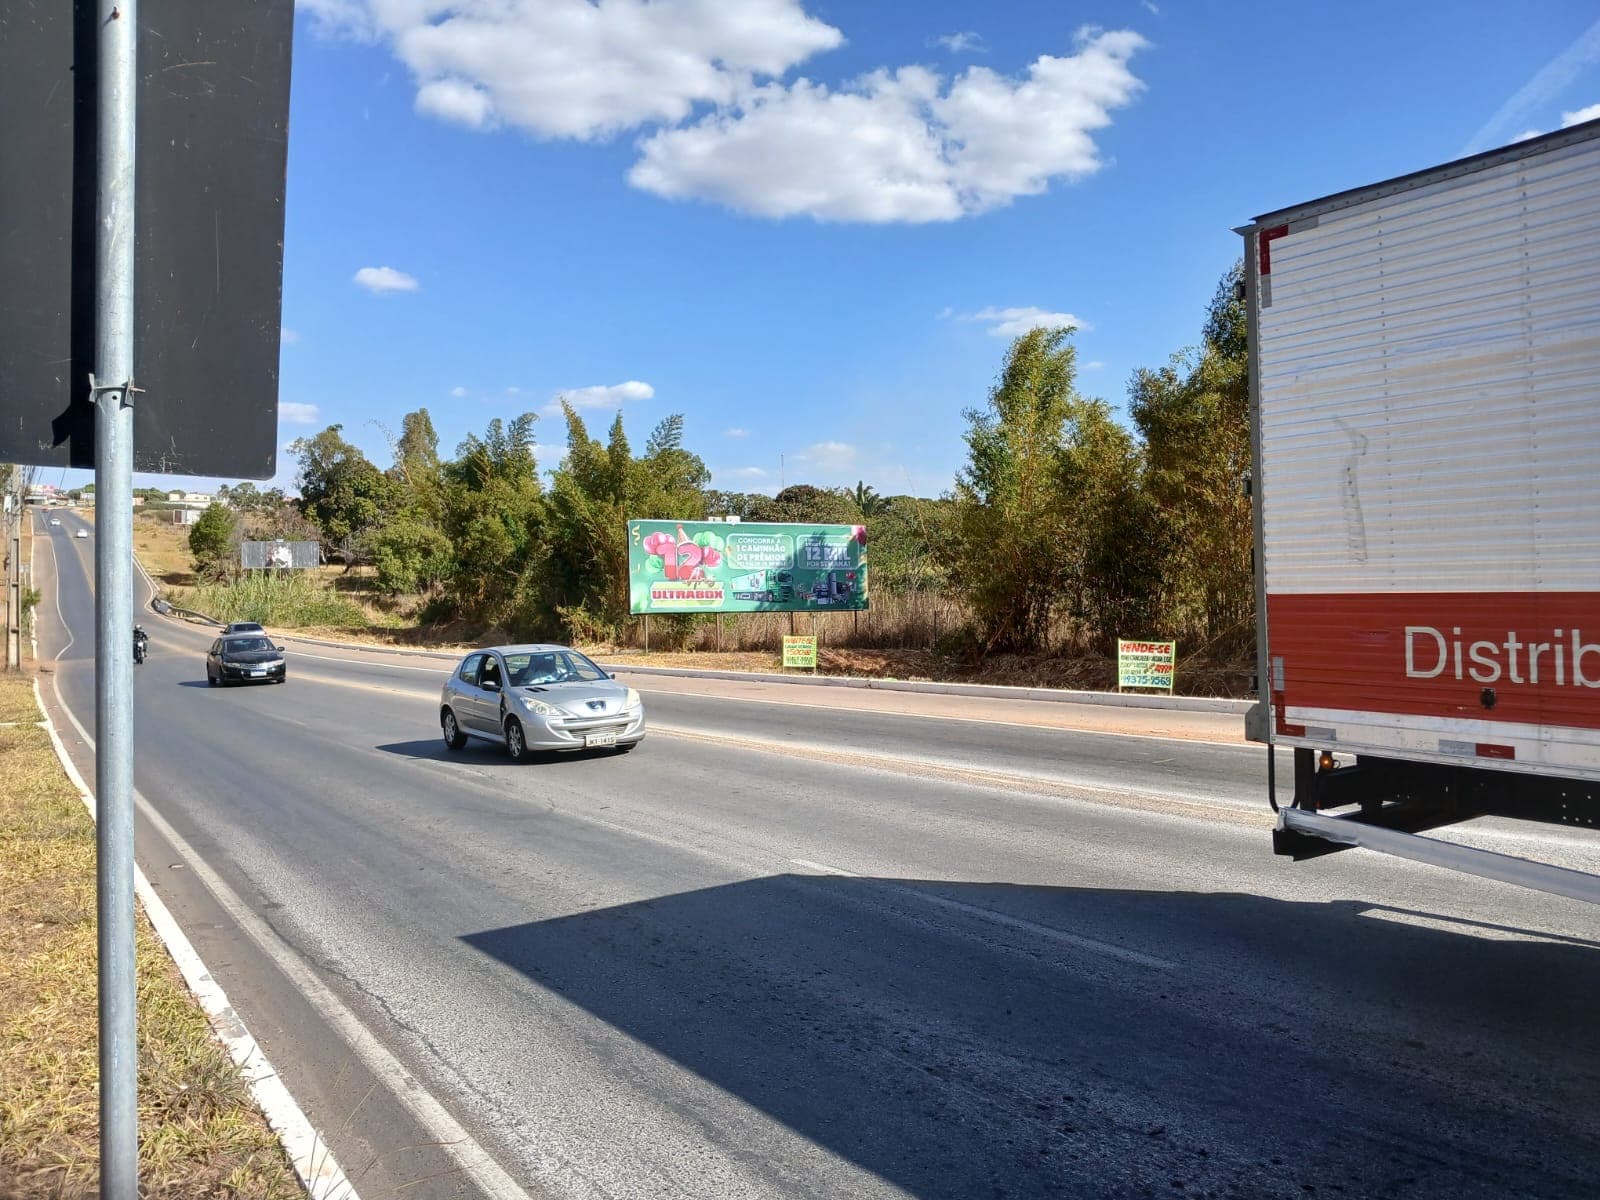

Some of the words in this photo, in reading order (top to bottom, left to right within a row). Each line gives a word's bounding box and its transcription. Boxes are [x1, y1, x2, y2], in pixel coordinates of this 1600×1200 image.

[655, 542, 703, 580] 12
[805, 547, 821, 561] 12
[823, 547, 851, 561] MIL
[652, 590, 723, 600] ULTRABOX
[1120, 642, 1171, 654] VENDE-SE
[1405, 626, 1600, 688] Distrib
